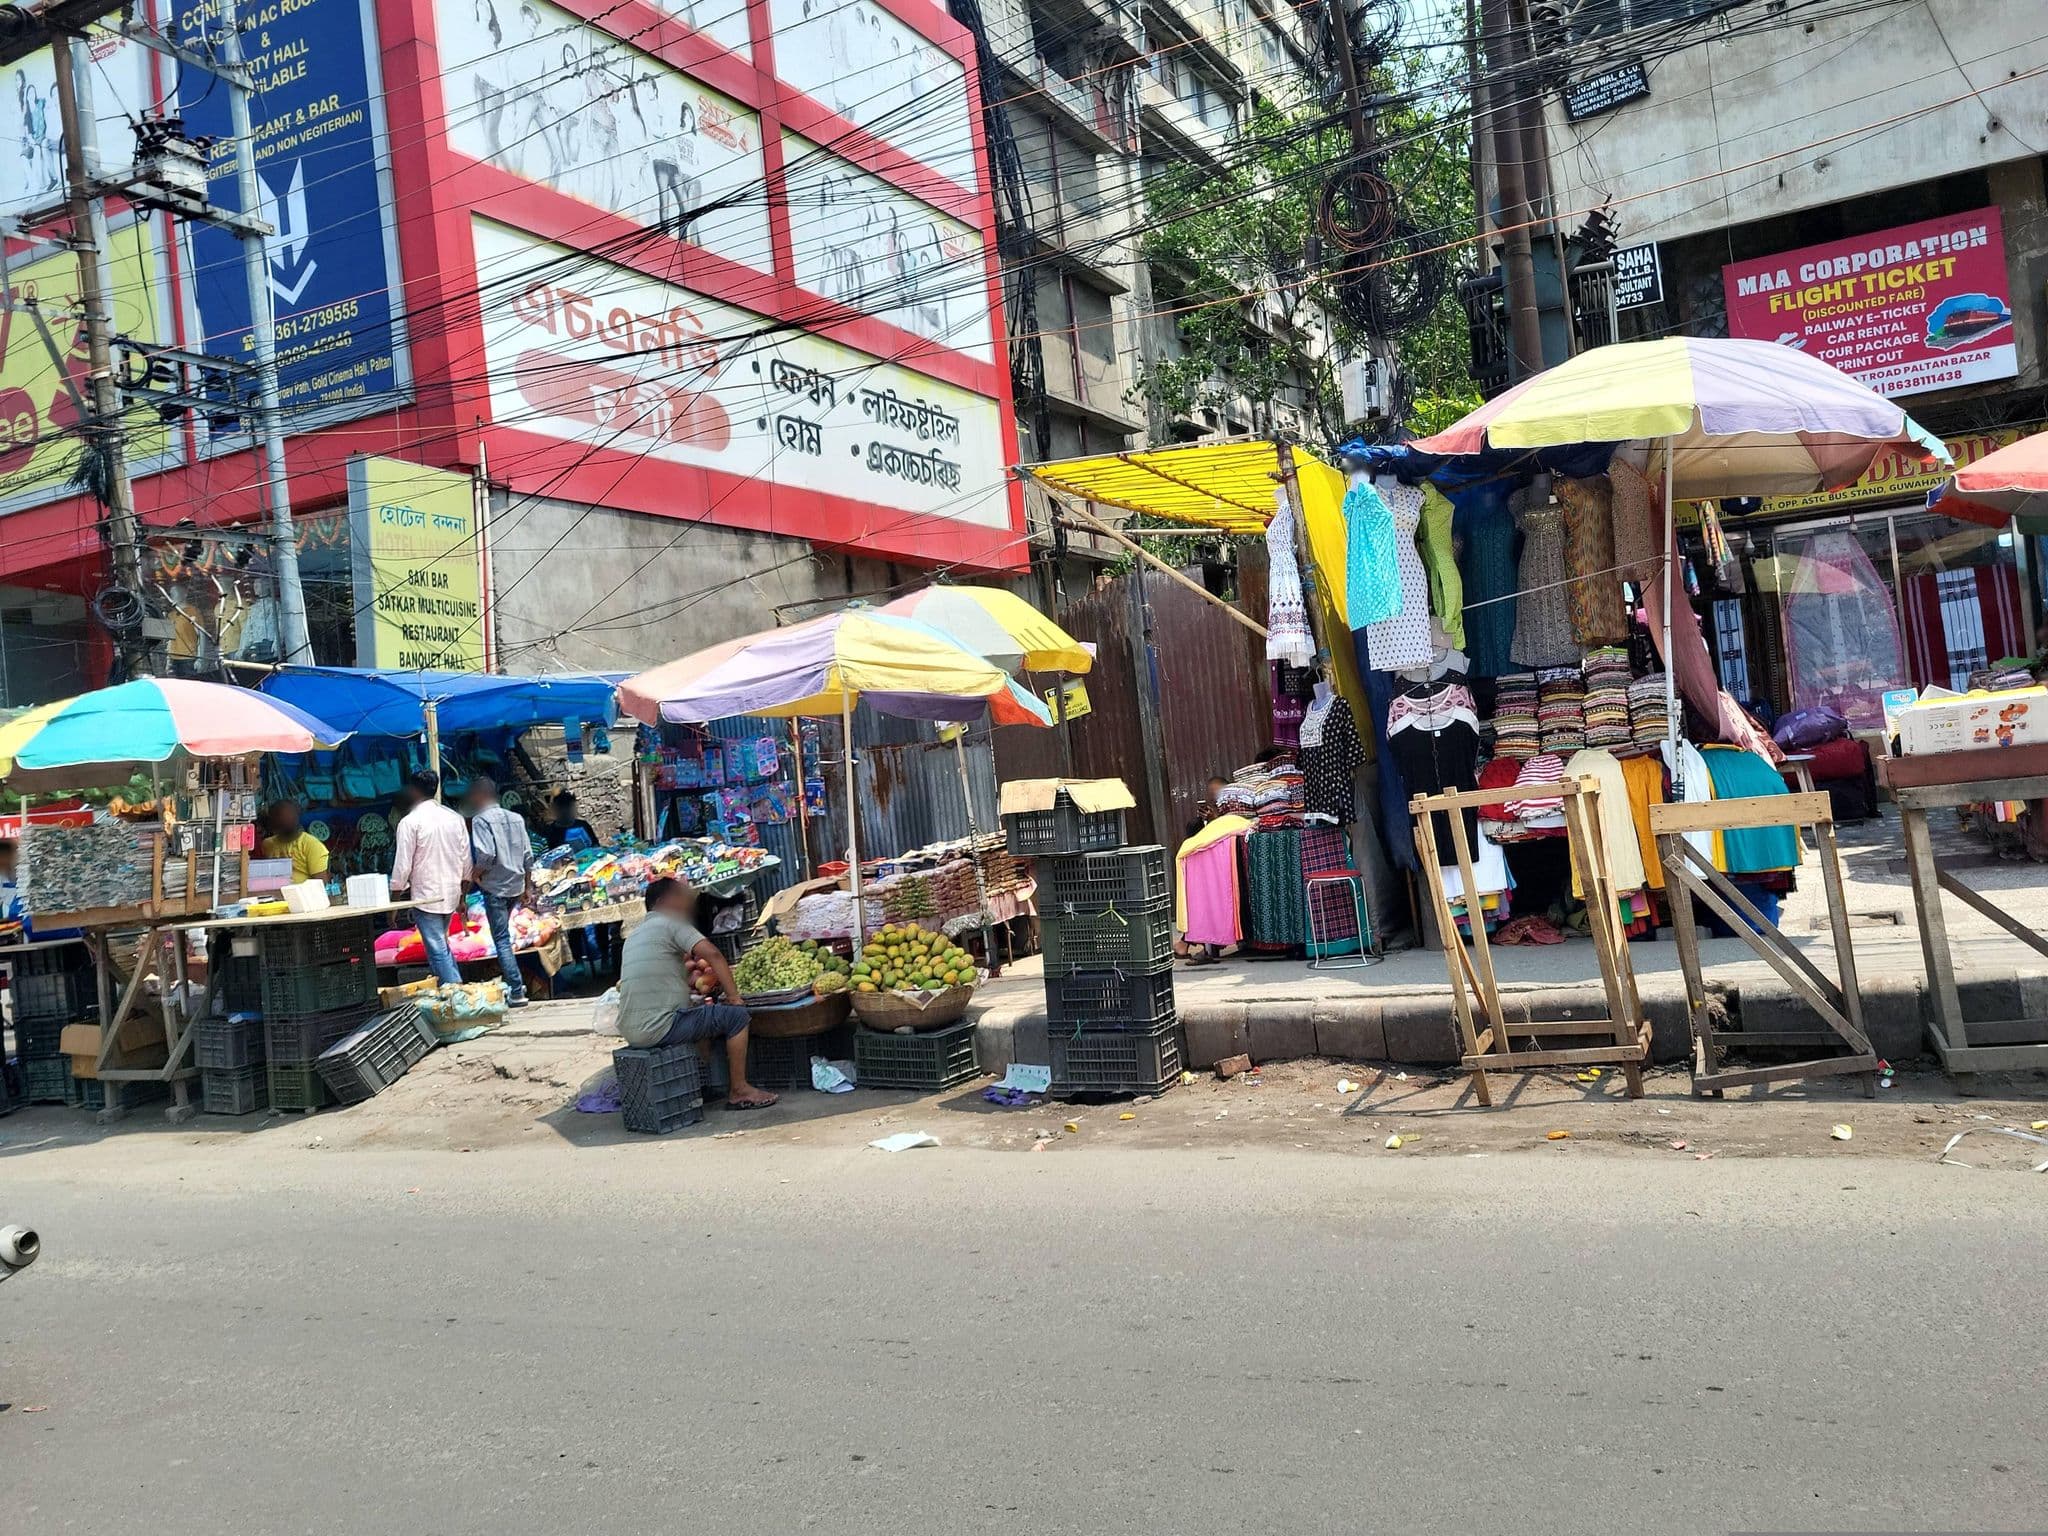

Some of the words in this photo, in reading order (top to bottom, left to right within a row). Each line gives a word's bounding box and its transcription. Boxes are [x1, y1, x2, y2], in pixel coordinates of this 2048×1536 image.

[259, 5, 278, 26] AC
[261, 32, 271, 48] &
[273, 38, 309, 66] HALL
[295, 108, 306, 126] &
[308, 94, 341, 119] BAR
[255, 147, 275, 162] AND
[276, 137, 299, 153] NON
[300, 109, 363, 144] VEGITERIAN)
[1616, 246, 1653, 271] SAHA
[1737, 269, 1791, 297] MAA
[1799, 225, 1988, 283] CORPORATION
[1768, 278, 1857, 314] FLIGHT
[1861, 256, 1957, 294] TICKET
[1802, 295, 1887, 323] (DISCOUNTED
[1888, 285, 1925, 305] FARE)
[1804, 315, 1864, 337] RAILWAY
[1866, 302, 1927, 325] E-TICKET
[1826, 331, 1855, 345] CAR
[1857, 321, 1908, 340] RENTAL
[1818, 344, 1854, 360] TOUR
[1855, 332, 1920, 355] PACKAGE
[1836, 355, 1875, 371] PRINT
[1875, 349, 1905, 363] OUT
[311, 372, 328, 391] Gold
[328, 367, 354, 387] Cinema
[353, 359, 370, 377] Hall,
[369, 356, 392, 373] Paltan
[1869, 368, 1902, 381] ROAD
[1903, 359, 1949, 374] PALTAN
[1950, 352, 1992, 367] BAZAR
[1887, 369, 1963, 392] 8638111438
[776, 414, 823, 457] হোম
[1801, 495, 1826, 506] ASTC
[1828, 492, 1848, 502] BUS
[1850, 486, 1887, 499] STAND,
[379, 505, 426, 529] হোটেল
[431, 513, 468, 536] বন্দনা
[407, 569, 429, 587] SAKI
[431, 572, 449, 589] BAR
[378, 593, 415, 613] SATKAR
[418, 597, 477, 618] MULTICUISINE
[402, 623, 459, 642] RESTAURANT
[399, 651, 440, 669] BANQUET
[443, 653, 465, 670] HALL
